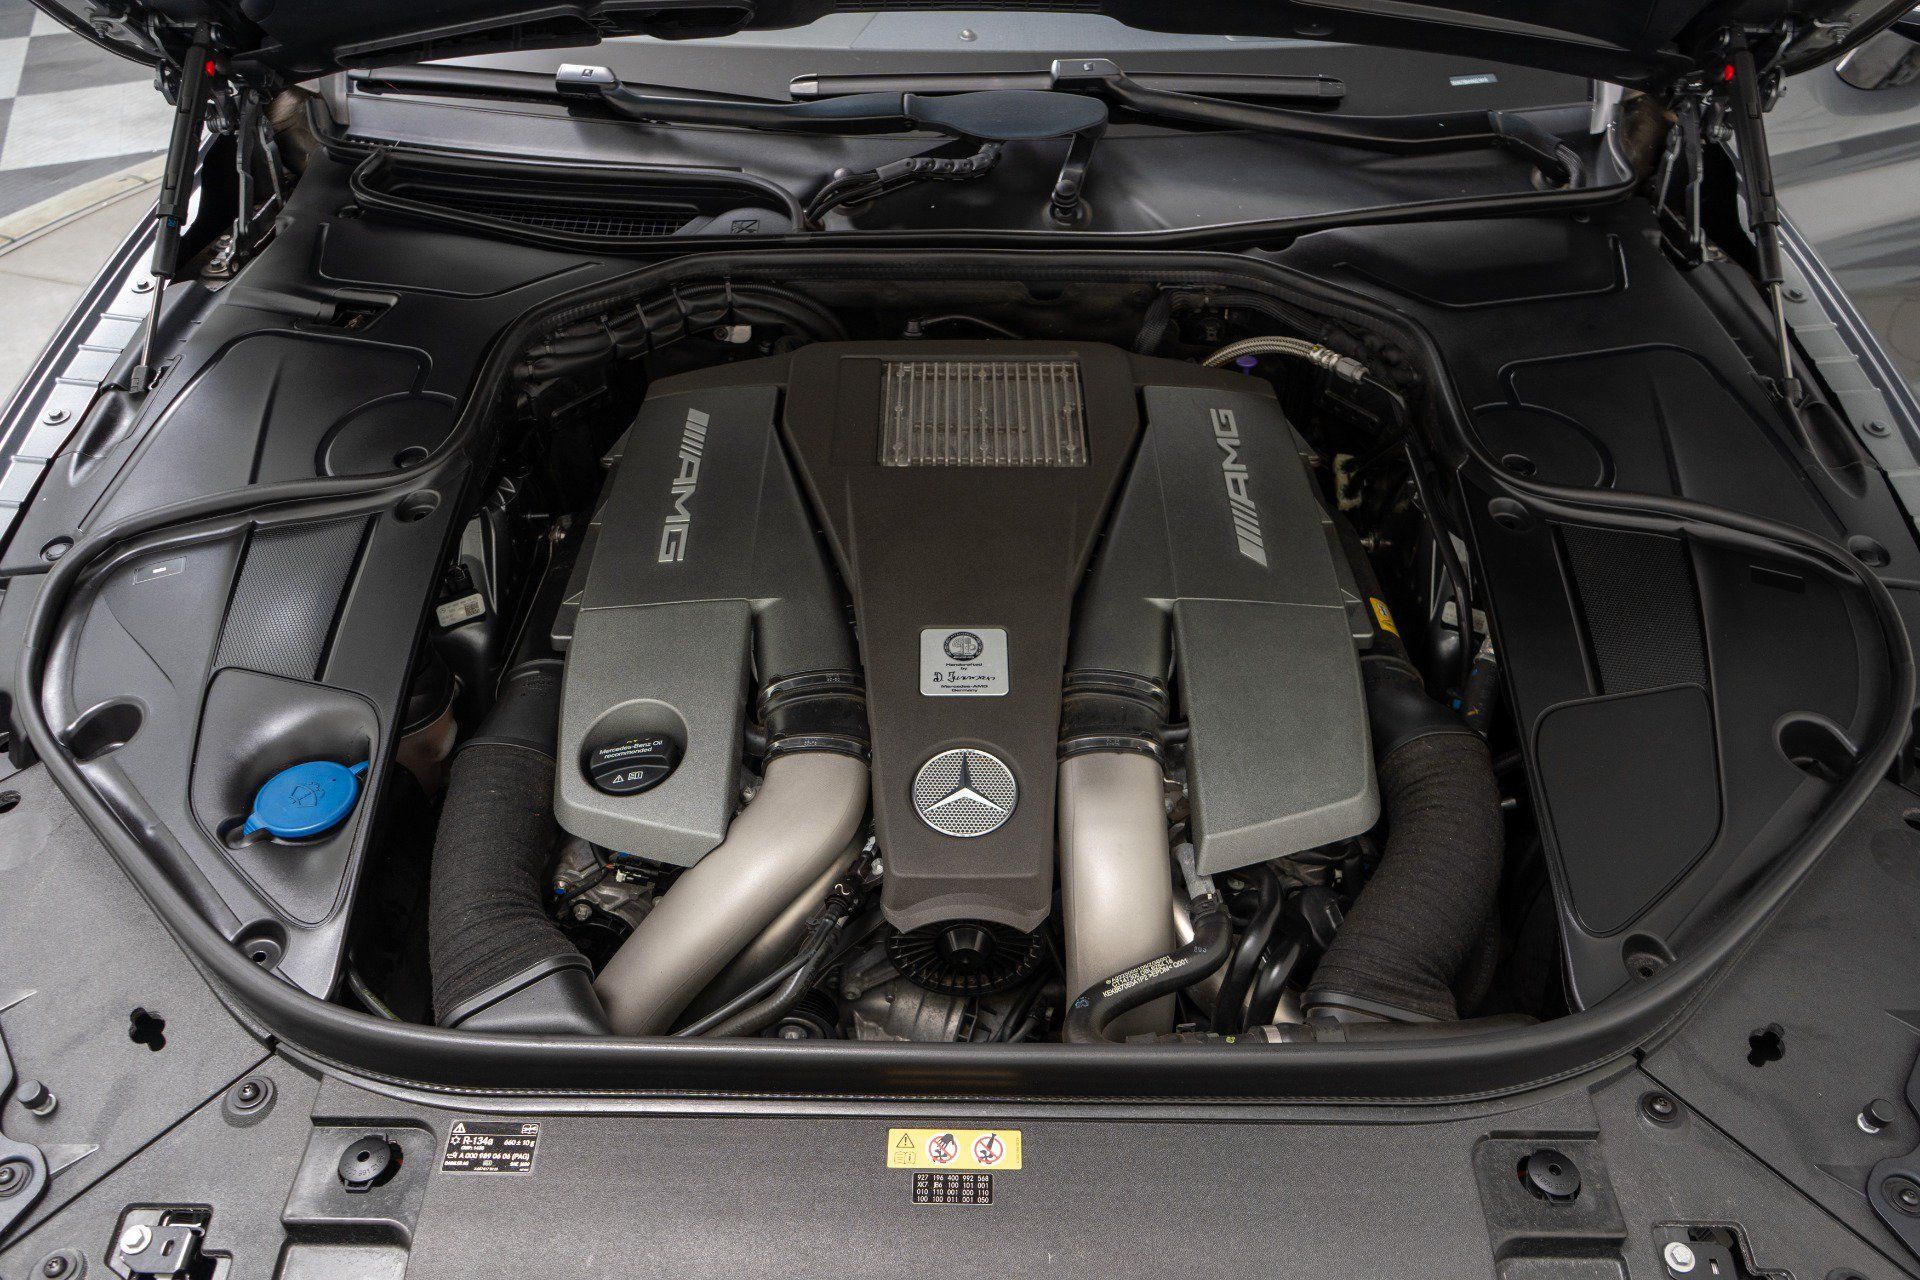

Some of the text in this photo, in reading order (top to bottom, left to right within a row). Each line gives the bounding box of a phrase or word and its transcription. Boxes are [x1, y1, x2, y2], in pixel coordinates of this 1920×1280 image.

[1209, 408, 1256, 512] AMG
[659, 448, 702, 563] AMG
[598, 742, 652, 755] Mercedes-Benz
[604, 746, 652, 759] recommended
[462, 1136, 494, 1146] R-134a
[512, 1153, 530, 1161] (PAG)
